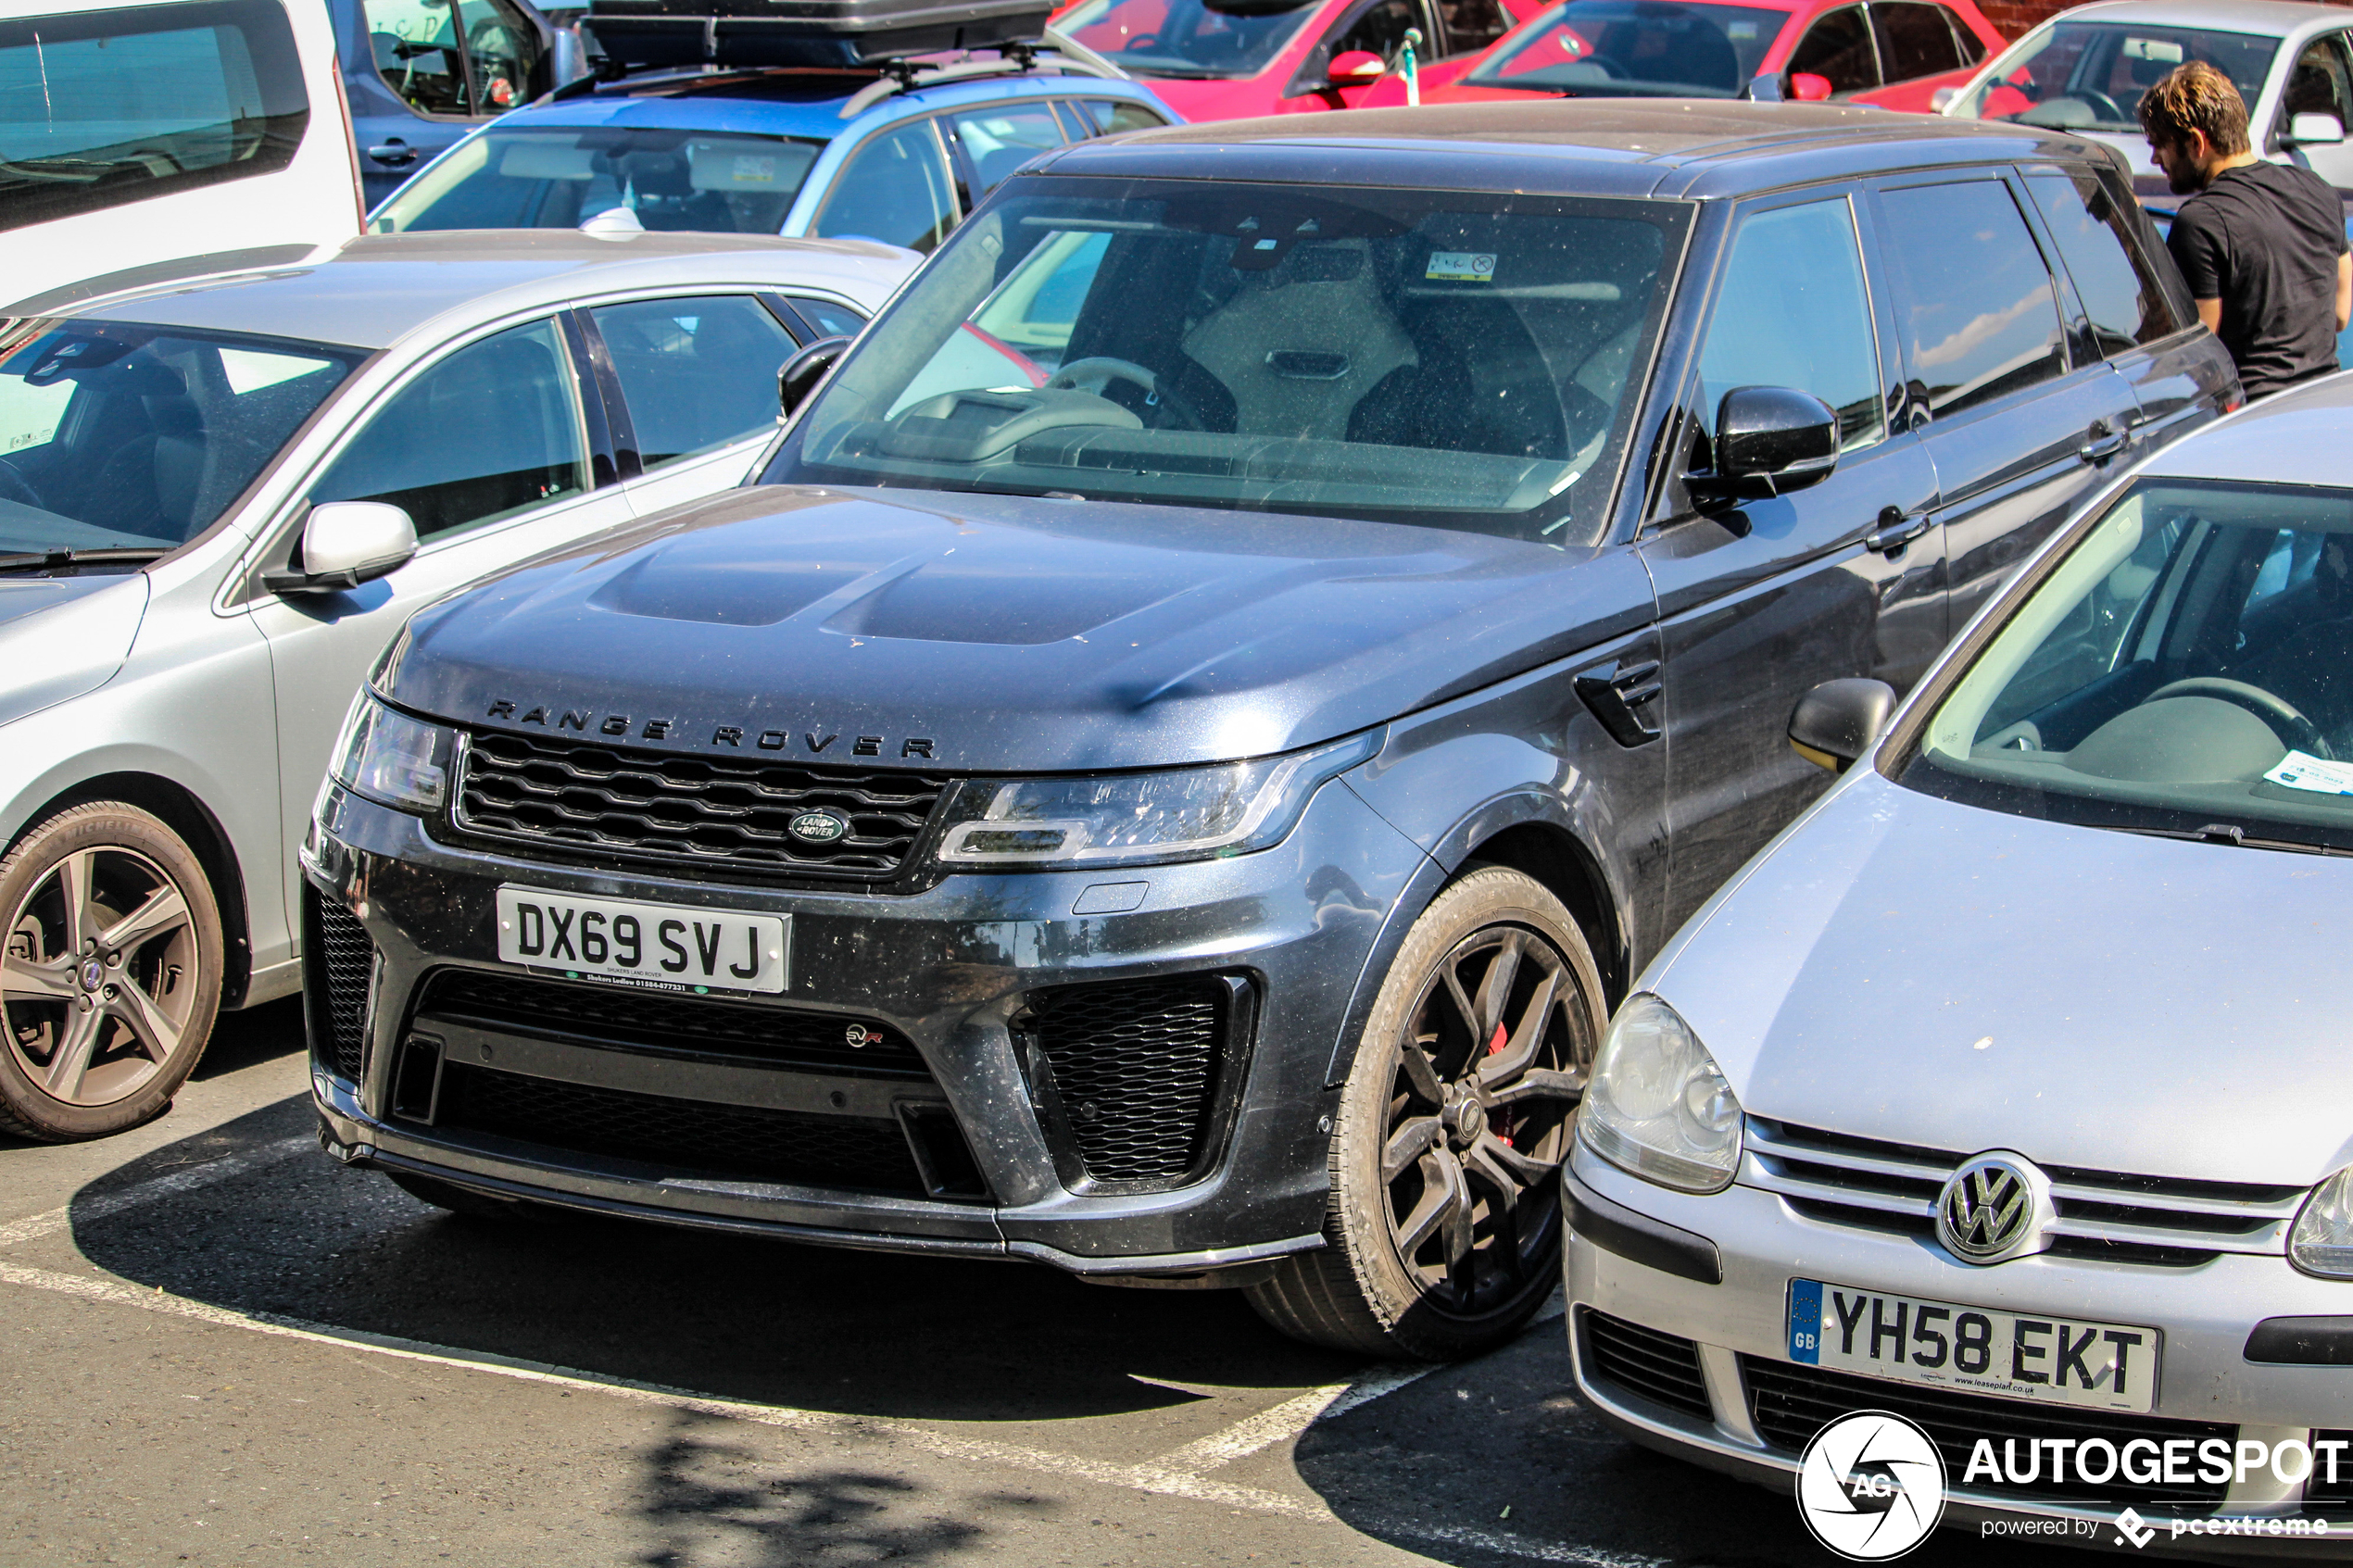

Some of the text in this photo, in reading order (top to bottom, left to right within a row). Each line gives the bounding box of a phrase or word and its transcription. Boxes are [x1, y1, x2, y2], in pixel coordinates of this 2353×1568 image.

[488, 698, 935, 759] RANGE ROVER
[801, 818, 827, 827] LAND
[801, 826, 834, 836] ROVER
[517, 902, 759, 979] DX69 SVJ
[587, 974, 611, 984] Shukers
[612, 977, 635, 986] Ludlow
[1795, 1332, 1816, 1350] GB
[1832, 1291, 2143, 1394] YH58 EKT
[1955, 1376, 2034, 1394] www.leaseplan.co.uk
